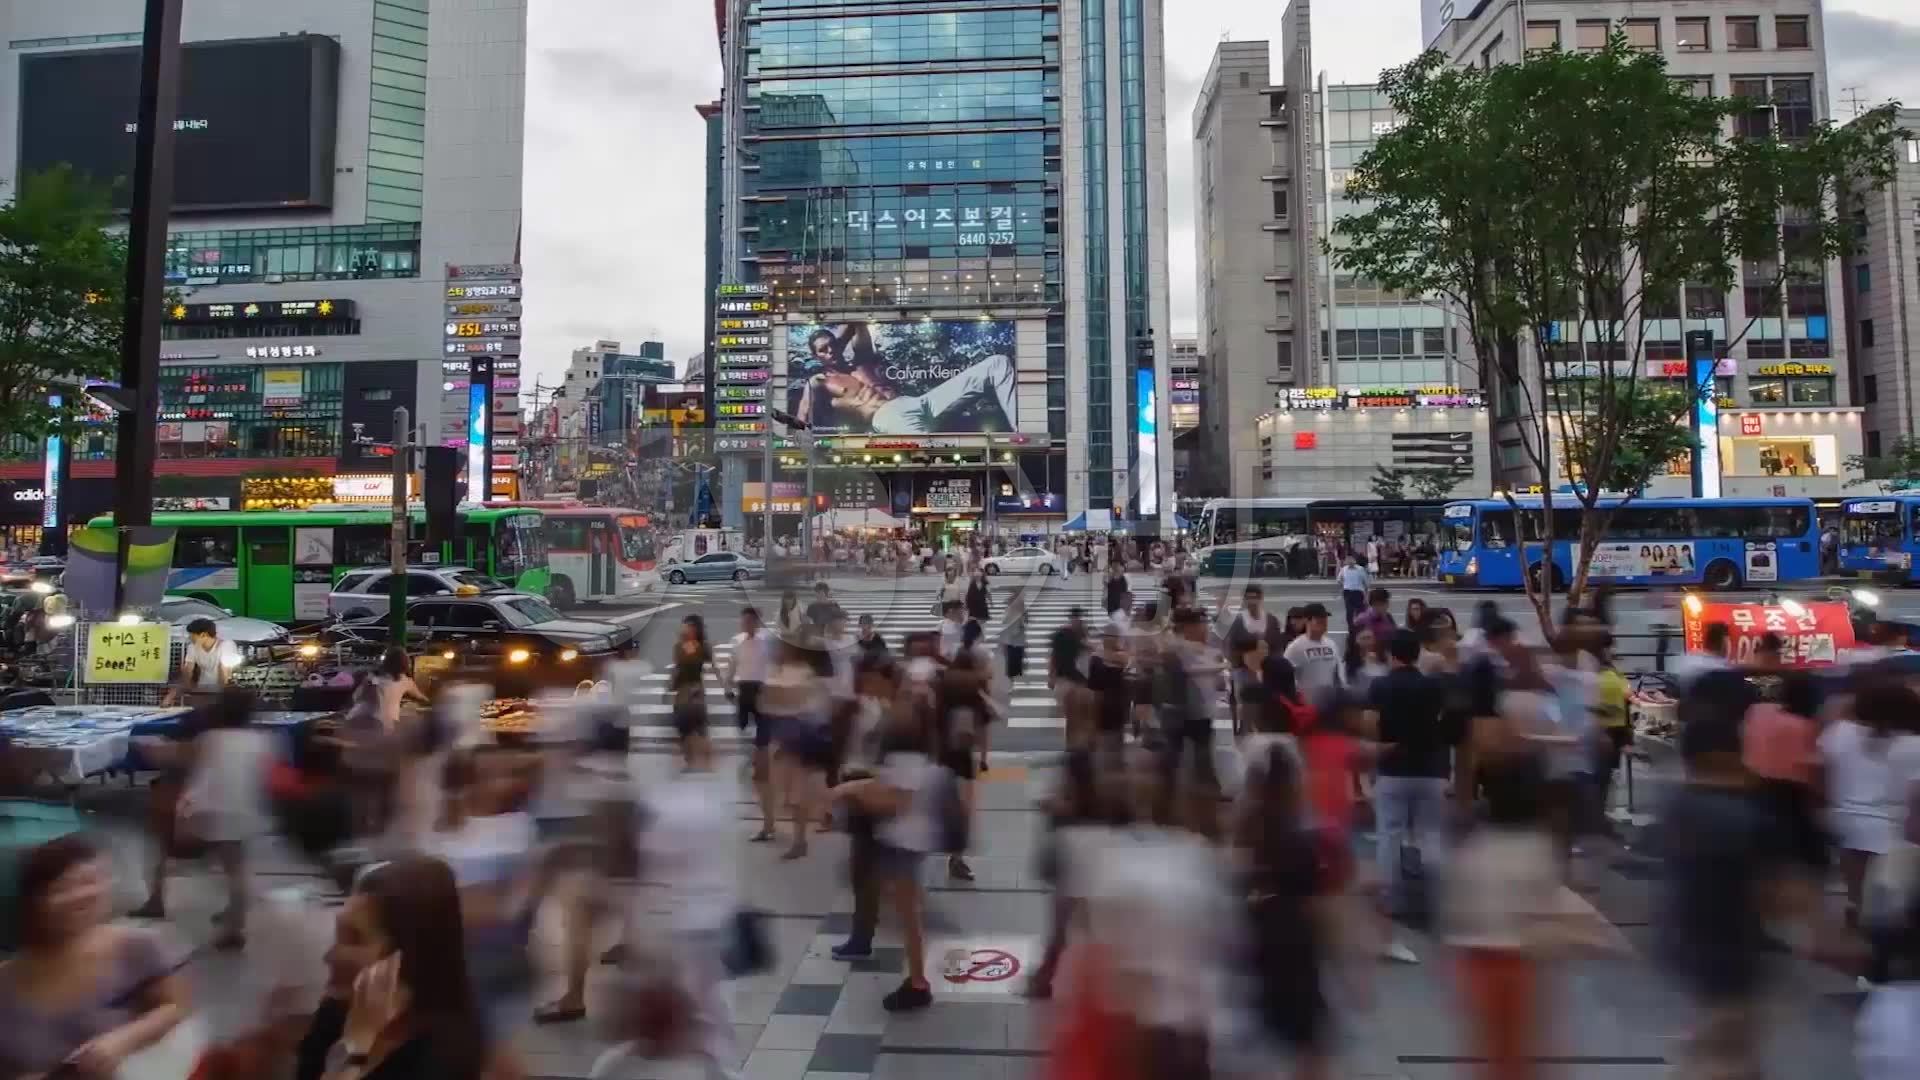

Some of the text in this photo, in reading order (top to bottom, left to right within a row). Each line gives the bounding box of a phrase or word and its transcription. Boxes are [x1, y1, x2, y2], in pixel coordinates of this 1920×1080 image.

[960, 232, 1014, 245] 6440 5252
[458, 323, 481, 336] ESL
[885, 366, 960, 380] Calvin Klein
[1743, 417, 1759, 425] UNI
[1743, 424, 1760, 434] QLO
[14, 489, 45, 501] adid
[102, 631, 136, 647] 아이스
[95, 656, 136, 672] 5000원
